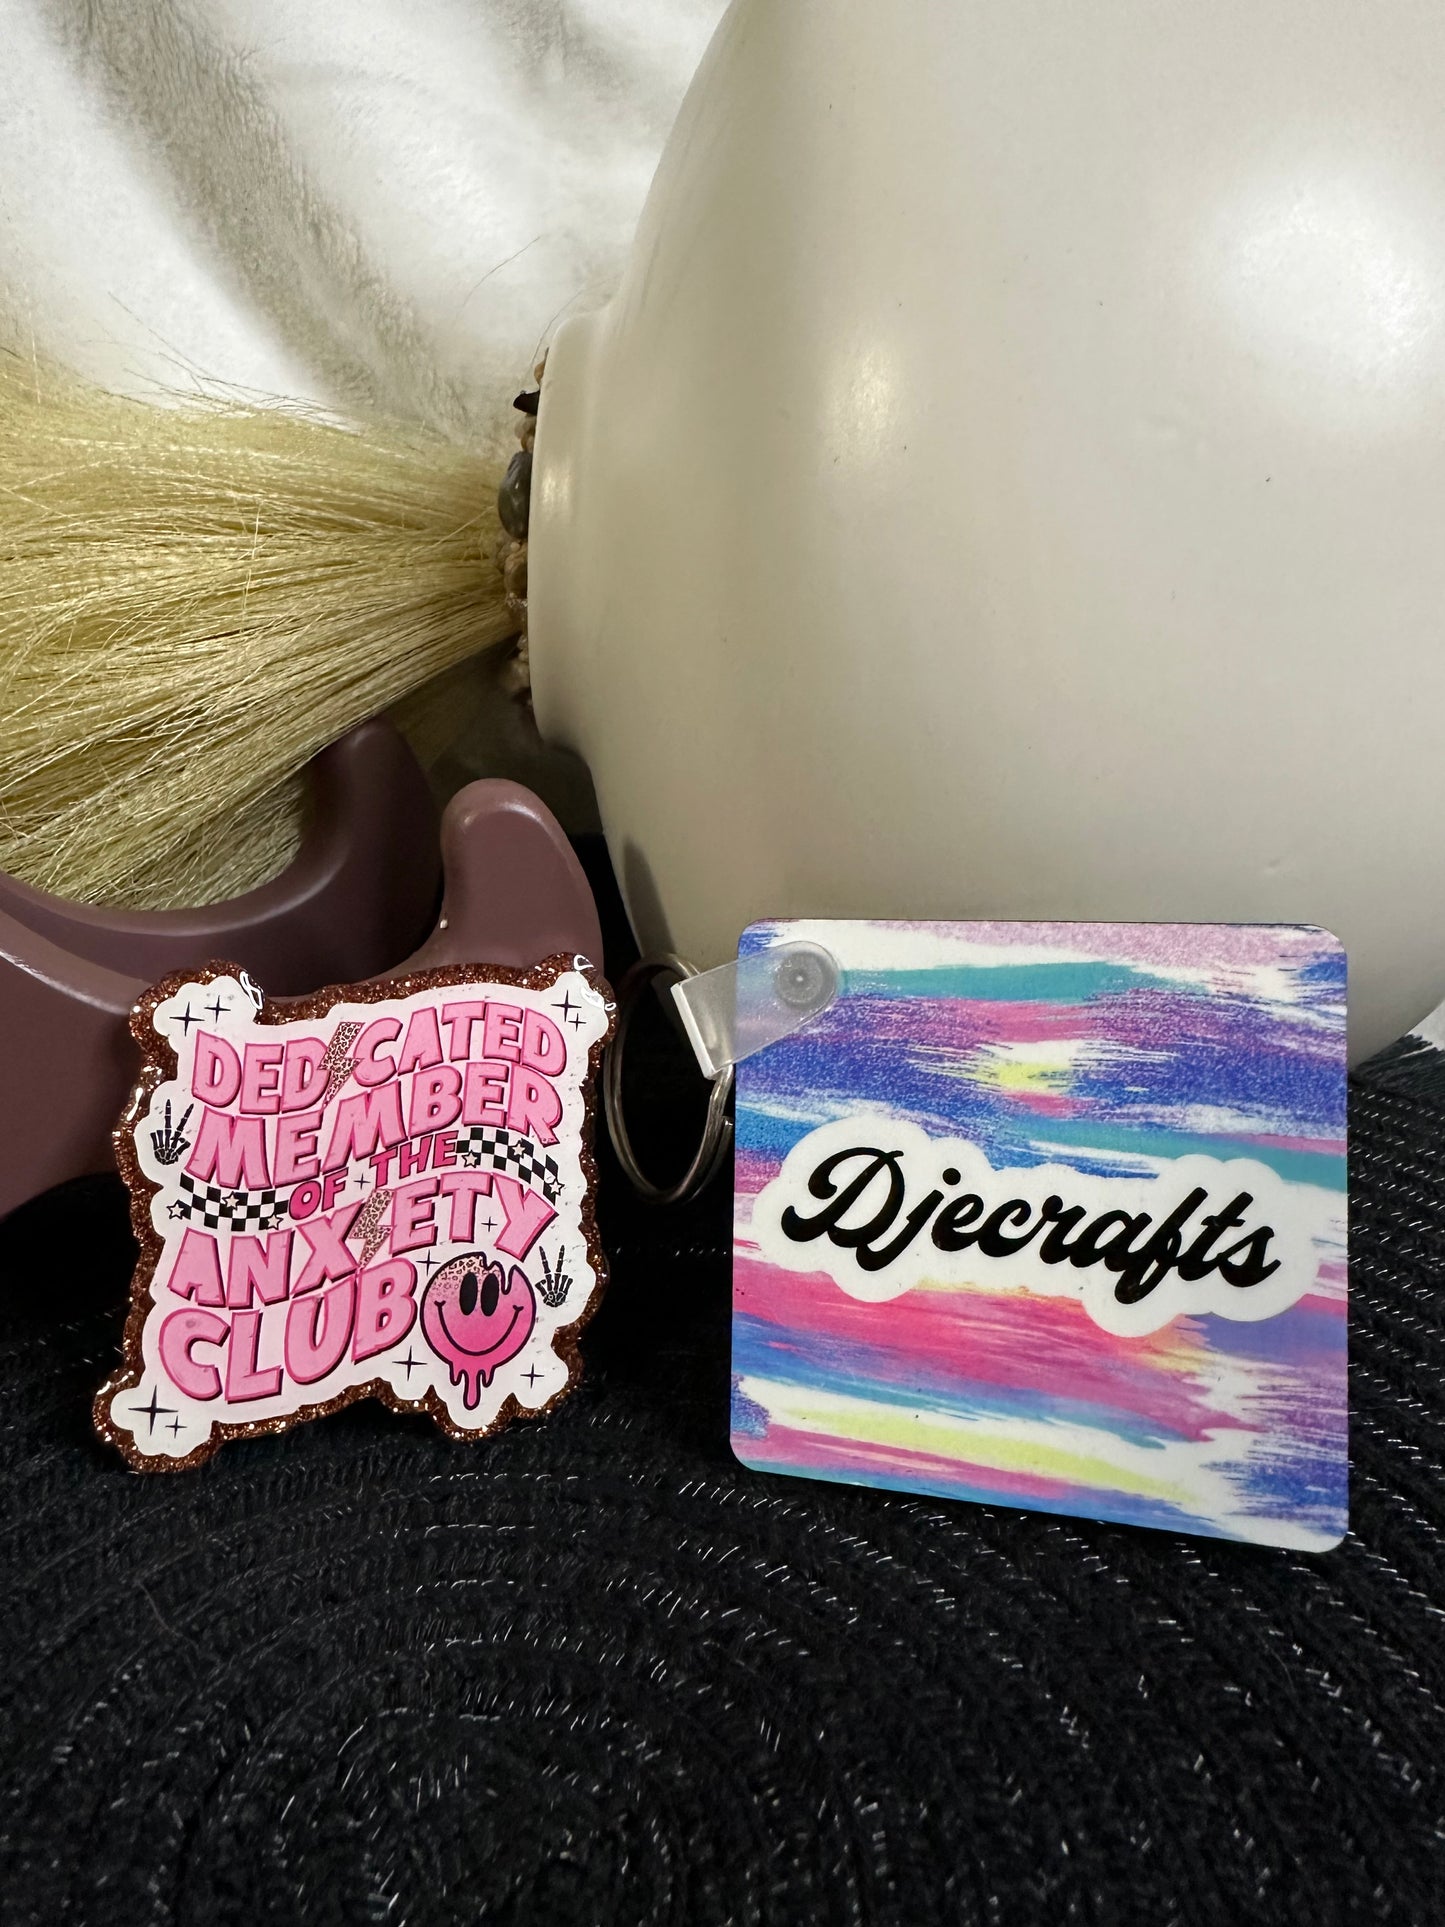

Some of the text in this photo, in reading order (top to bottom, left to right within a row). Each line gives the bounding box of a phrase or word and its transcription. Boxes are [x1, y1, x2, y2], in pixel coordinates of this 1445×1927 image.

[192, 1000, 567, 1115] DEDICATED
[186, 1062, 563, 1191] MEMBER
[289, 1130, 459, 1221] OF THE
[167, 1171, 559, 1309] ANXIETY
[780, 1146, 1282, 1305] Djecrafts
[158, 1257, 418, 1404] CLUB
